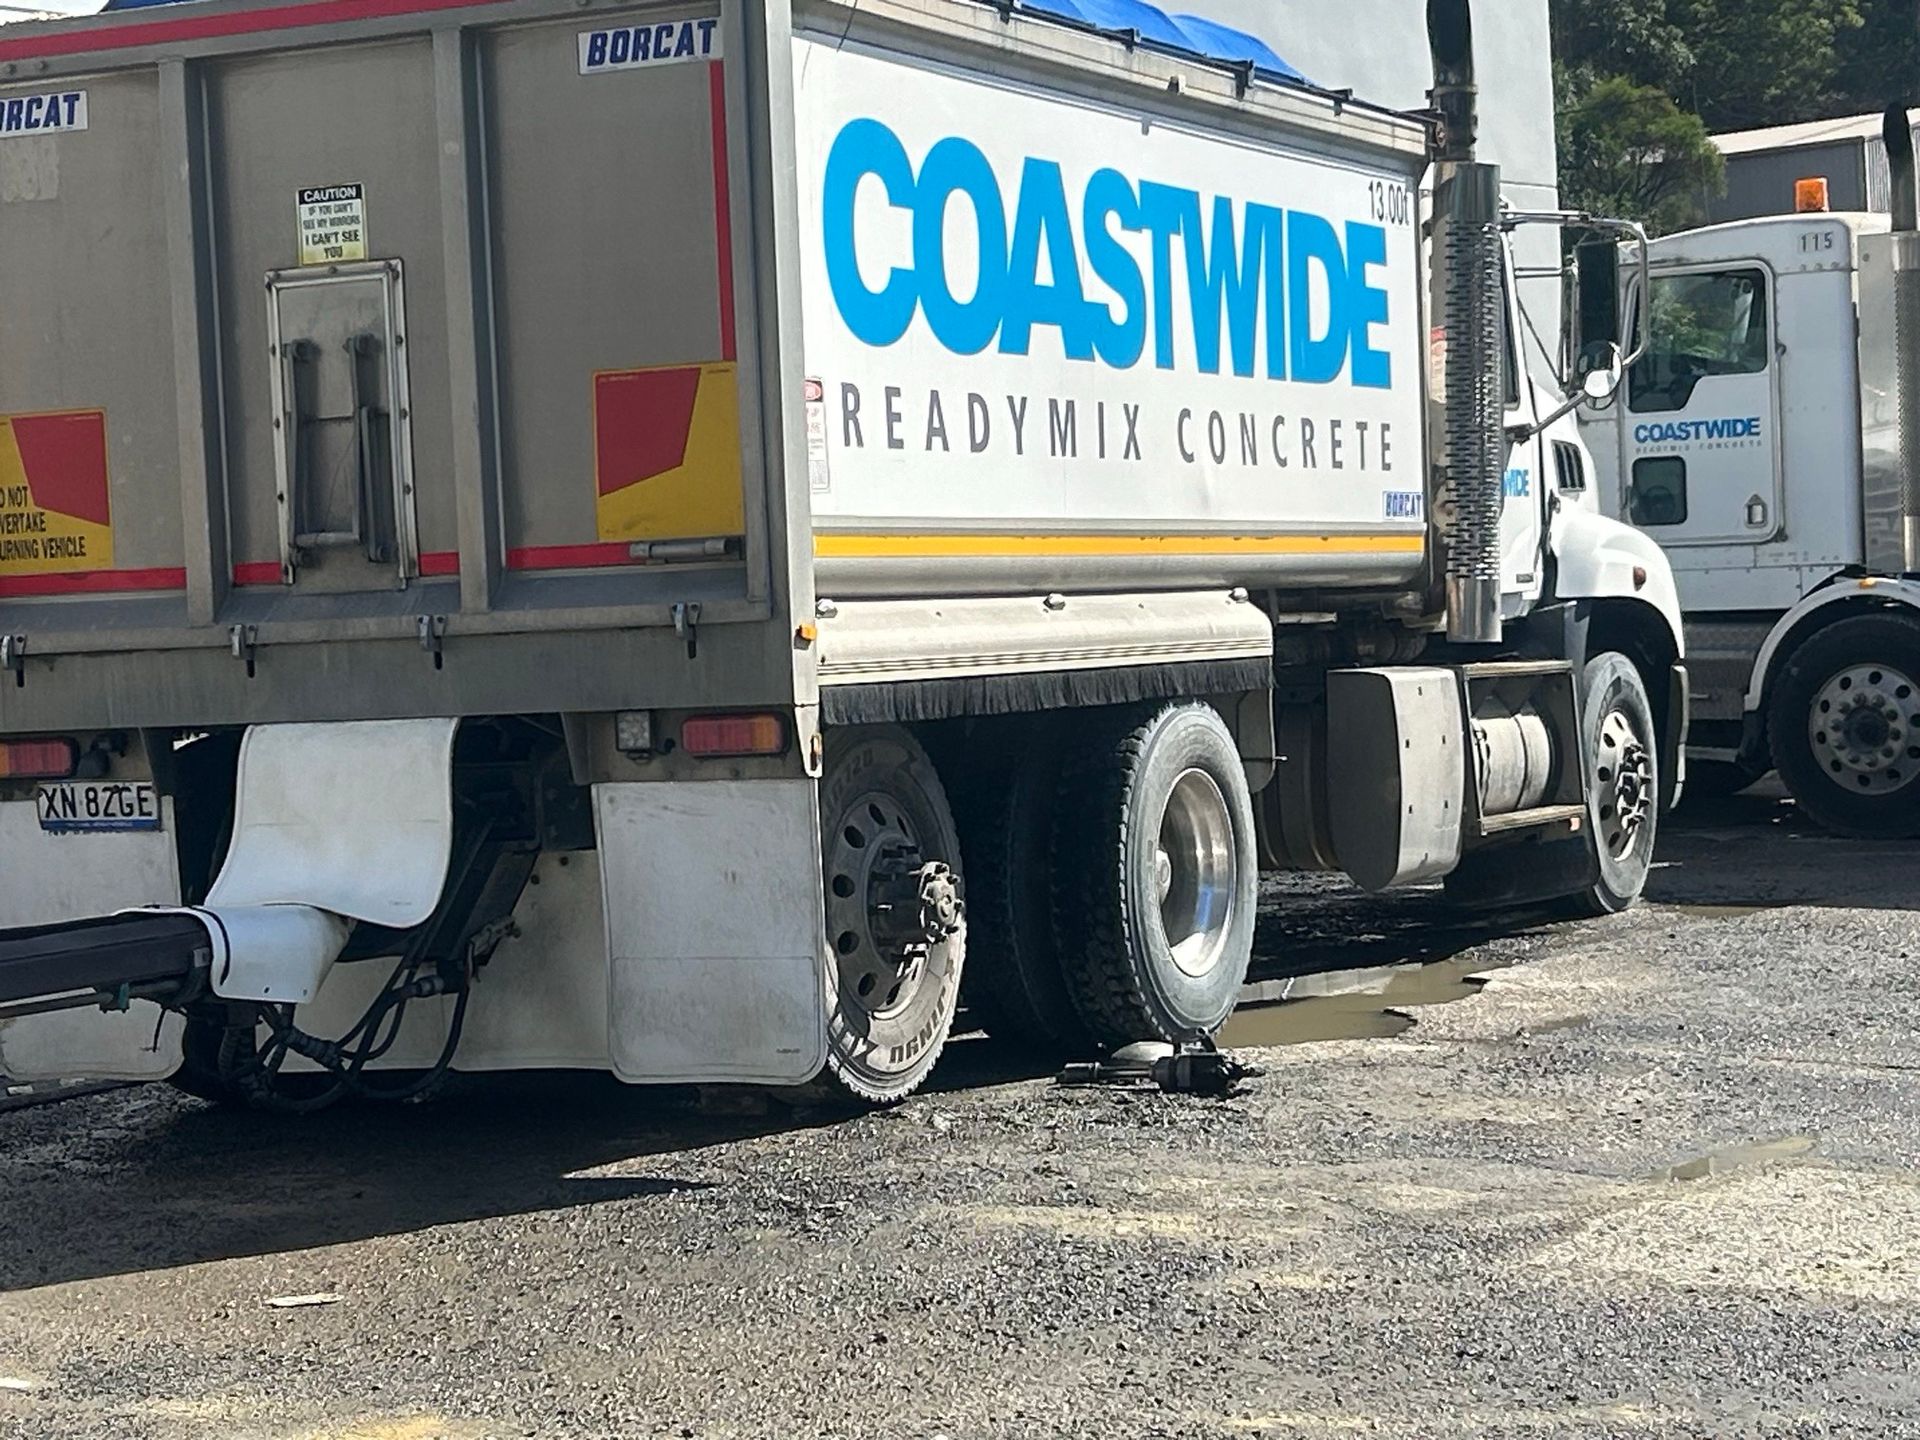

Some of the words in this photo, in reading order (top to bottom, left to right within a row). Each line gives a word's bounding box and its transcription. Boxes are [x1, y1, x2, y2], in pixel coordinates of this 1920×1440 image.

[587, 20, 717, 66] BORCAT
[0, 94, 80, 132] RCAT
[304, 186, 357, 202] CAUTION
[1368, 180, 1410, 226] 13.00t
[318, 205, 332, 215] YOU
[305, 234, 310, 245] I
[311, 231, 339, 246] CAN'T
[341, 229, 360, 242] SEE
[1801, 230, 1834, 253] 115
[324, 246, 343, 259] YOU
[823, 118, 1392, 389] COASTWIDE
[841, 382, 1142, 461] READYMIX
[1178, 408, 1393, 472] CONCRETE
[1634, 416, 1761, 444] COASTWIDE
[8, 486, 28, 508] NOT
[1385, 493, 1422, 518] BORCAT
[0, 511, 46, 535] VERTAKE
[0, 539, 39, 561] URNING
[41, 535, 87, 559] VEHICLE
[40, 786, 77, 819] XN
